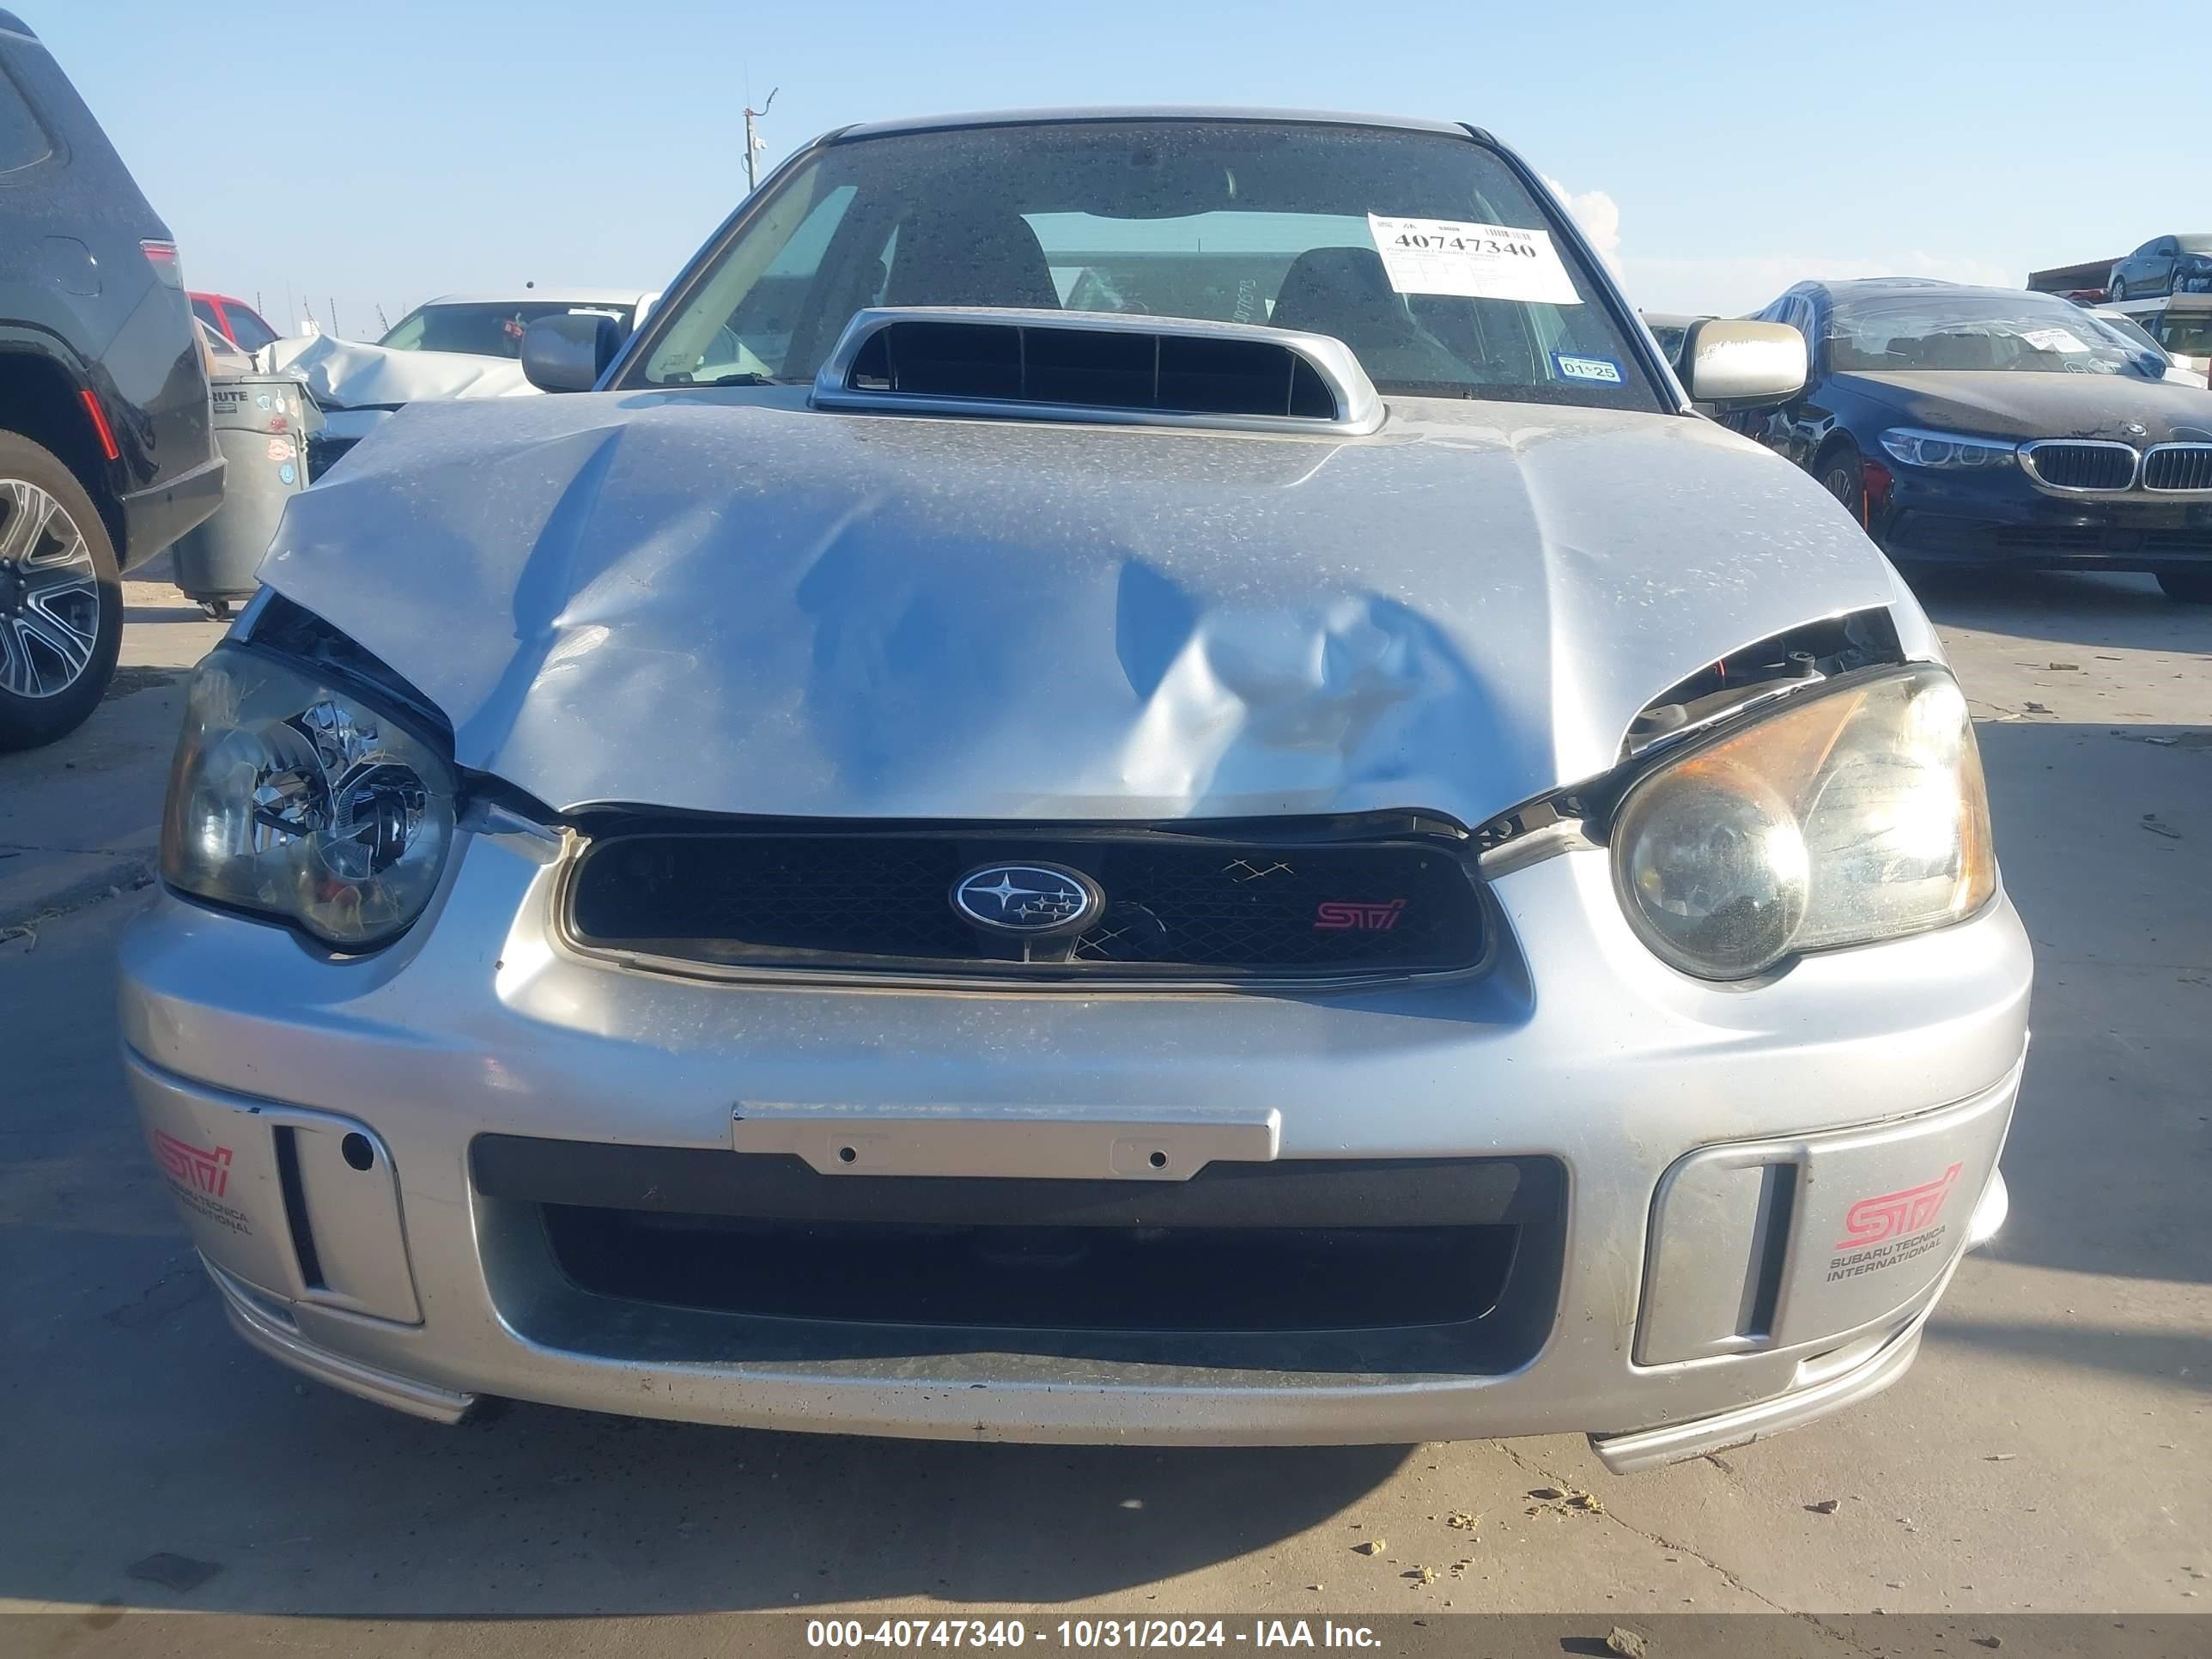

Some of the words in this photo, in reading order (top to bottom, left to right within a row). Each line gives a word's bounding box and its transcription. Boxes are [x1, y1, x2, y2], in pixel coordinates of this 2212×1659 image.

[1395, 234, 1536, 258] 40747340
[1565, 363, 1584, 374] 01
[1594, 368, 1616, 378] 25
[1826, 1237, 1942, 1283] INTERNATIONAL
[1830, 1245, 1893, 1269] SUBARU
[1895, 1225, 1946, 1253] TECNICA
